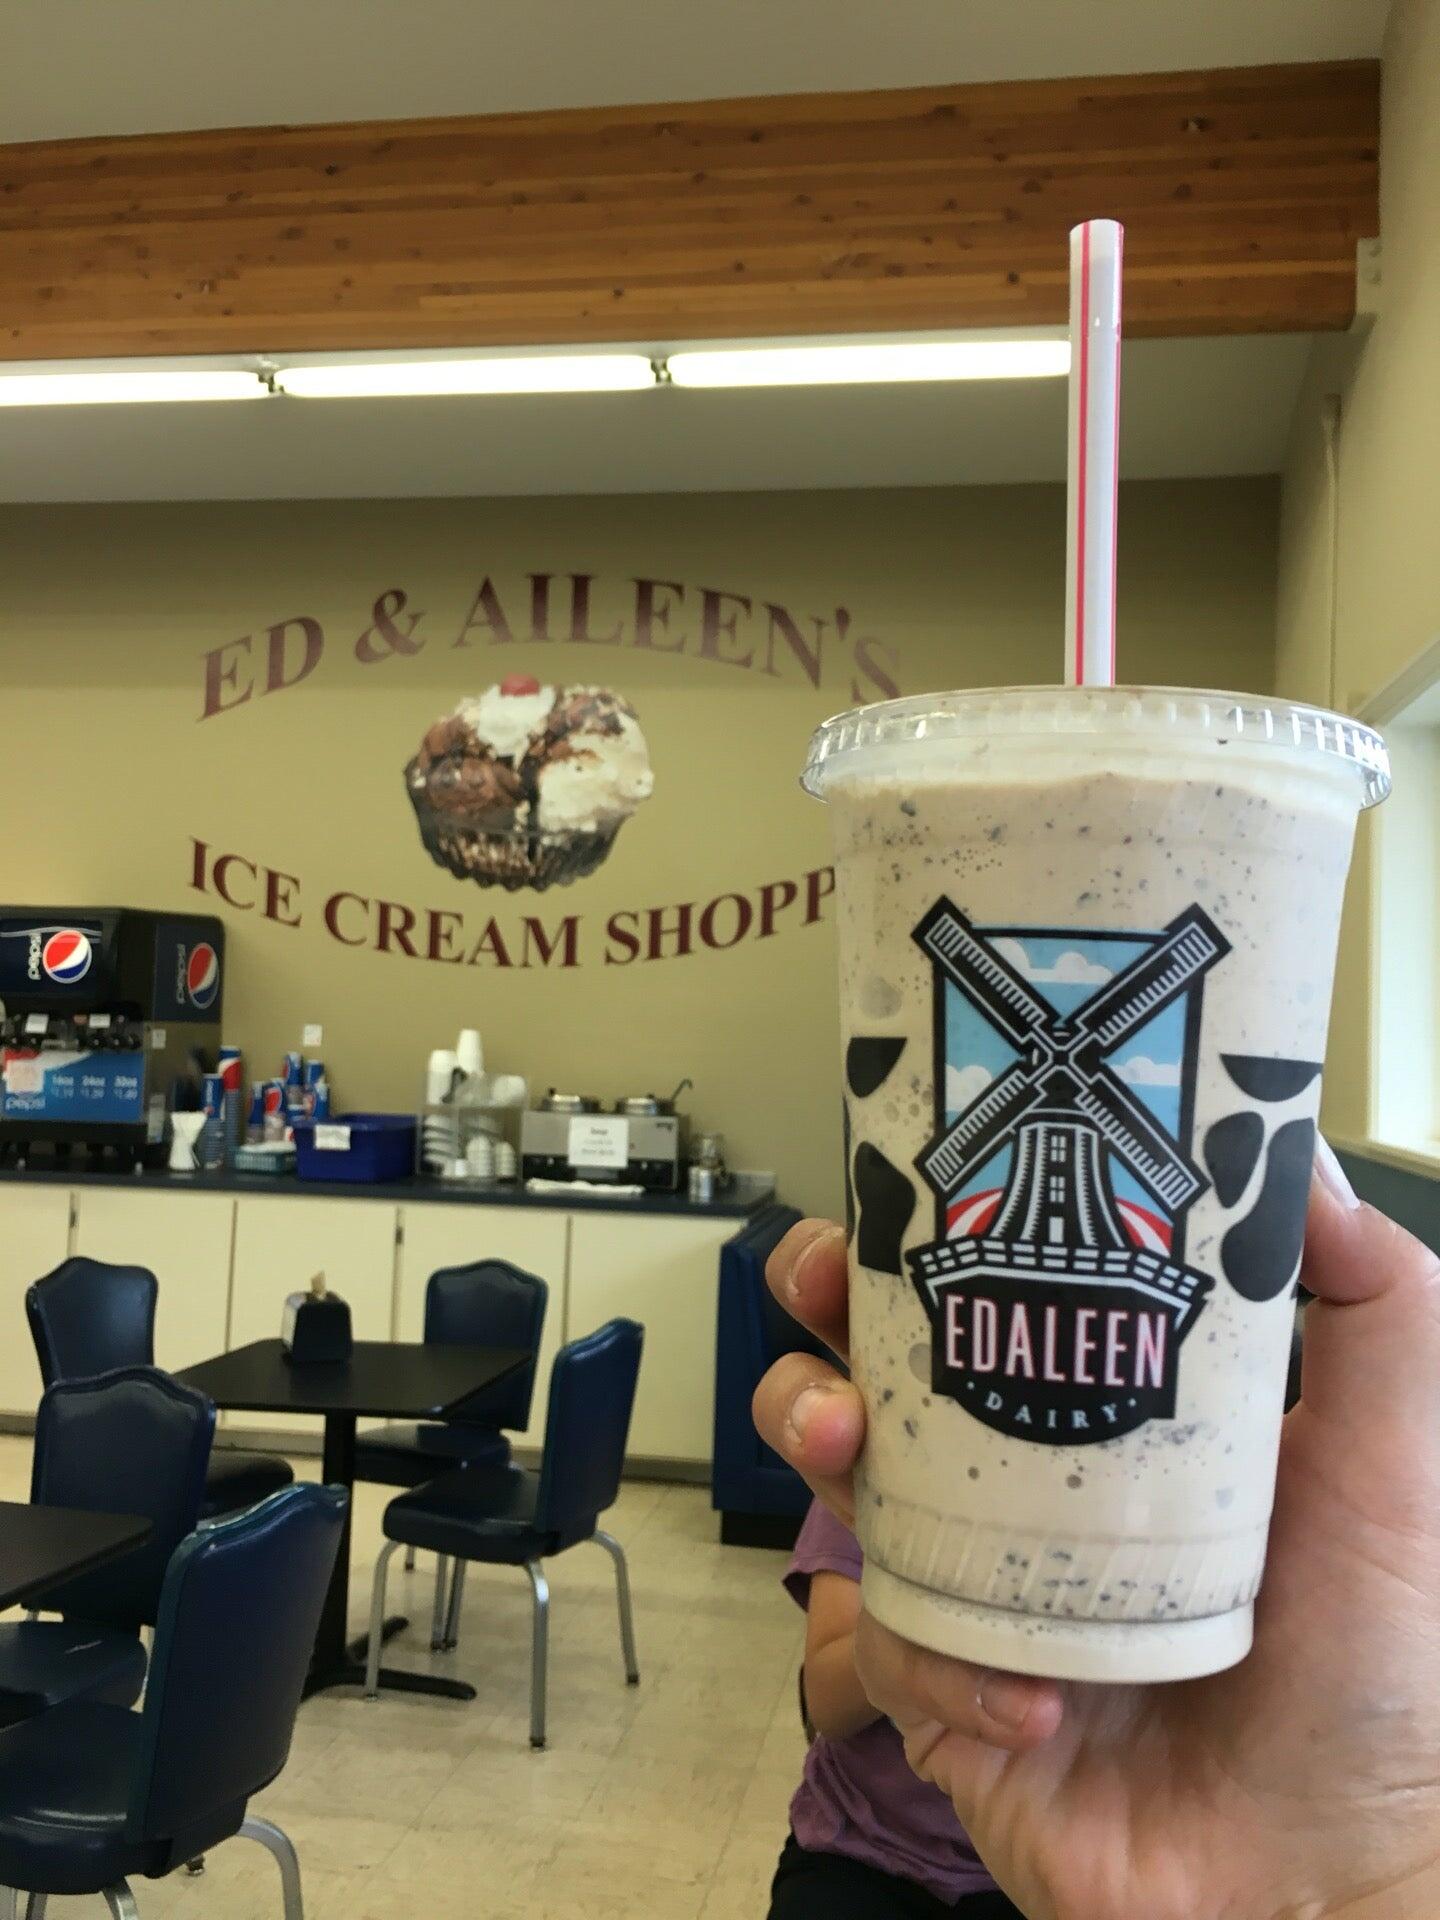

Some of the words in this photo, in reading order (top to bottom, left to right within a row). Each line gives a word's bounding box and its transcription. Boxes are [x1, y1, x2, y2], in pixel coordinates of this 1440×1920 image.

[196, 616, 324, 722] ED
[354, 588, 428, 664] &
[450, 573, 901, 706] AILEEN'S
[188, 837, 302, 927] ICE
[324, 891, 582, 968] CREAM
[945, 1294, 1166, 1388] EDALEEN
[985, 1391, 1119, 1429] DAIRY
